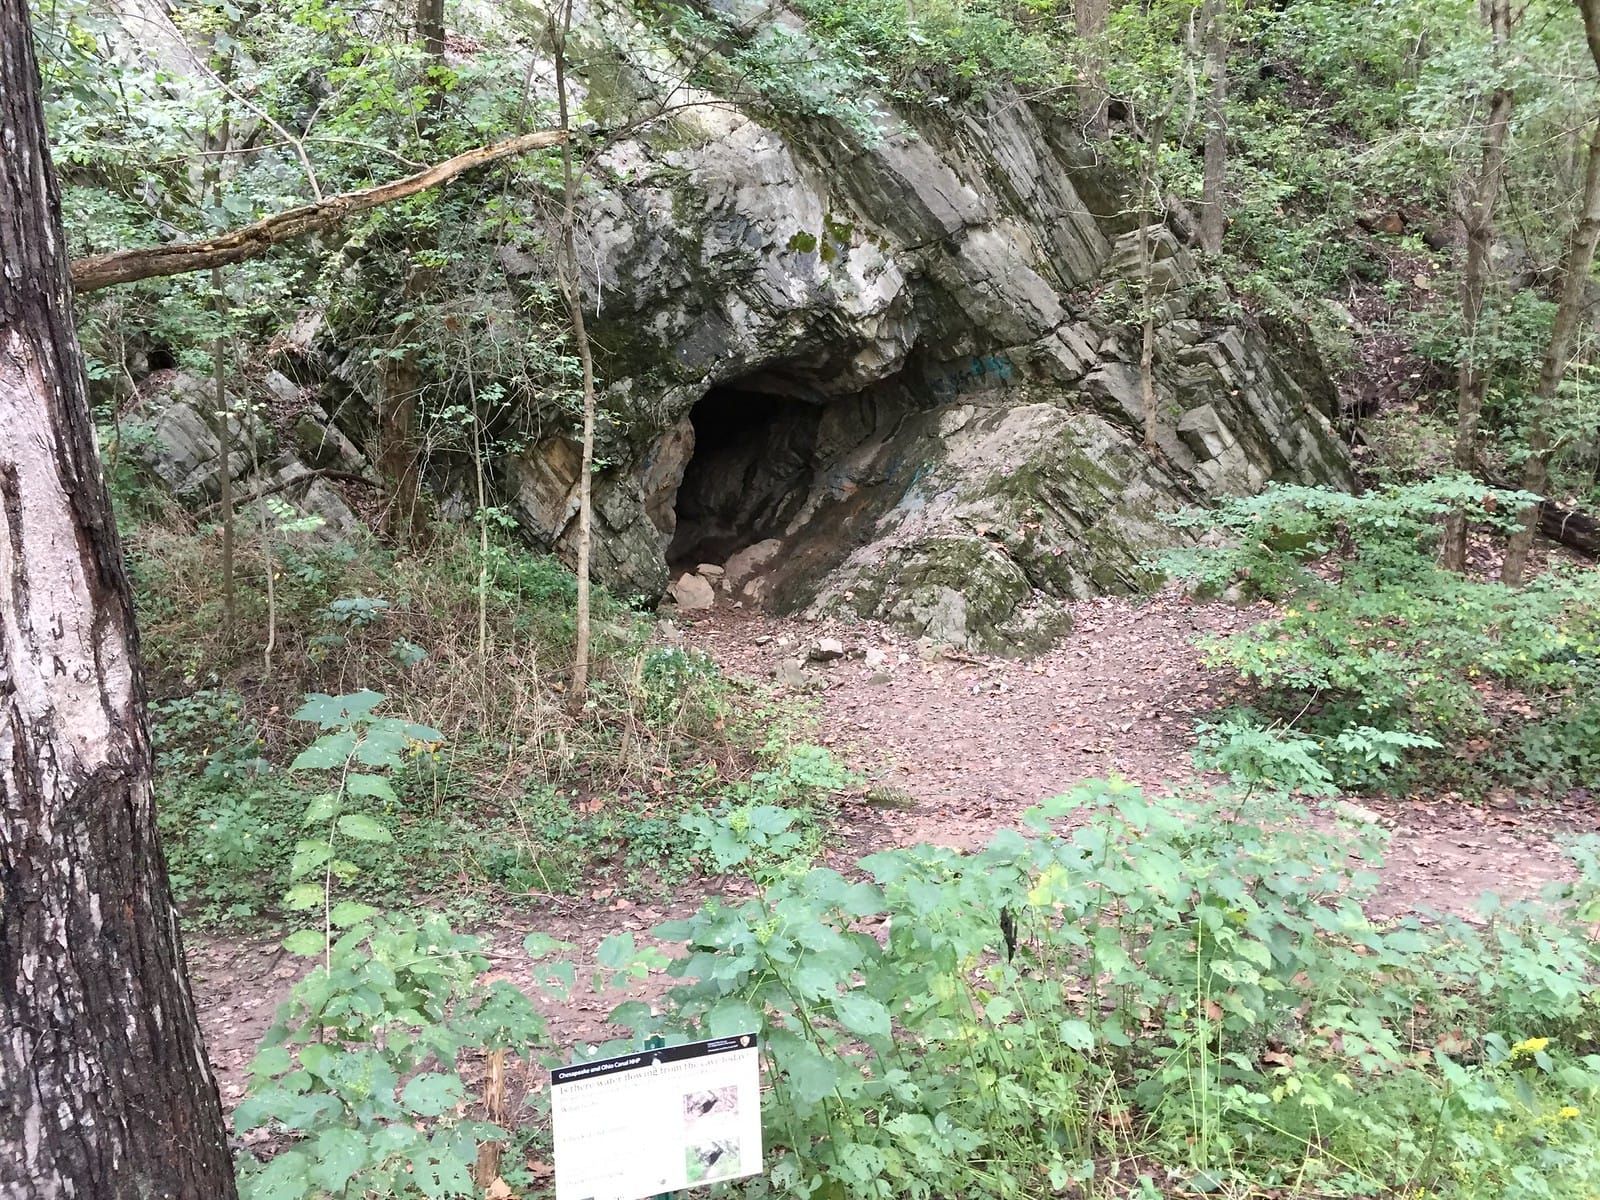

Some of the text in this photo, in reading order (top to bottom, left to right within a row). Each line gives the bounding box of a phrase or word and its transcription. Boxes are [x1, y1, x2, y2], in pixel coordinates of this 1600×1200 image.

[558, 1057, 641, 1079] Chesapeake and Ohio Canal NHP
[560, 1053, 748, 1095] Is there water flowing from the cave today
